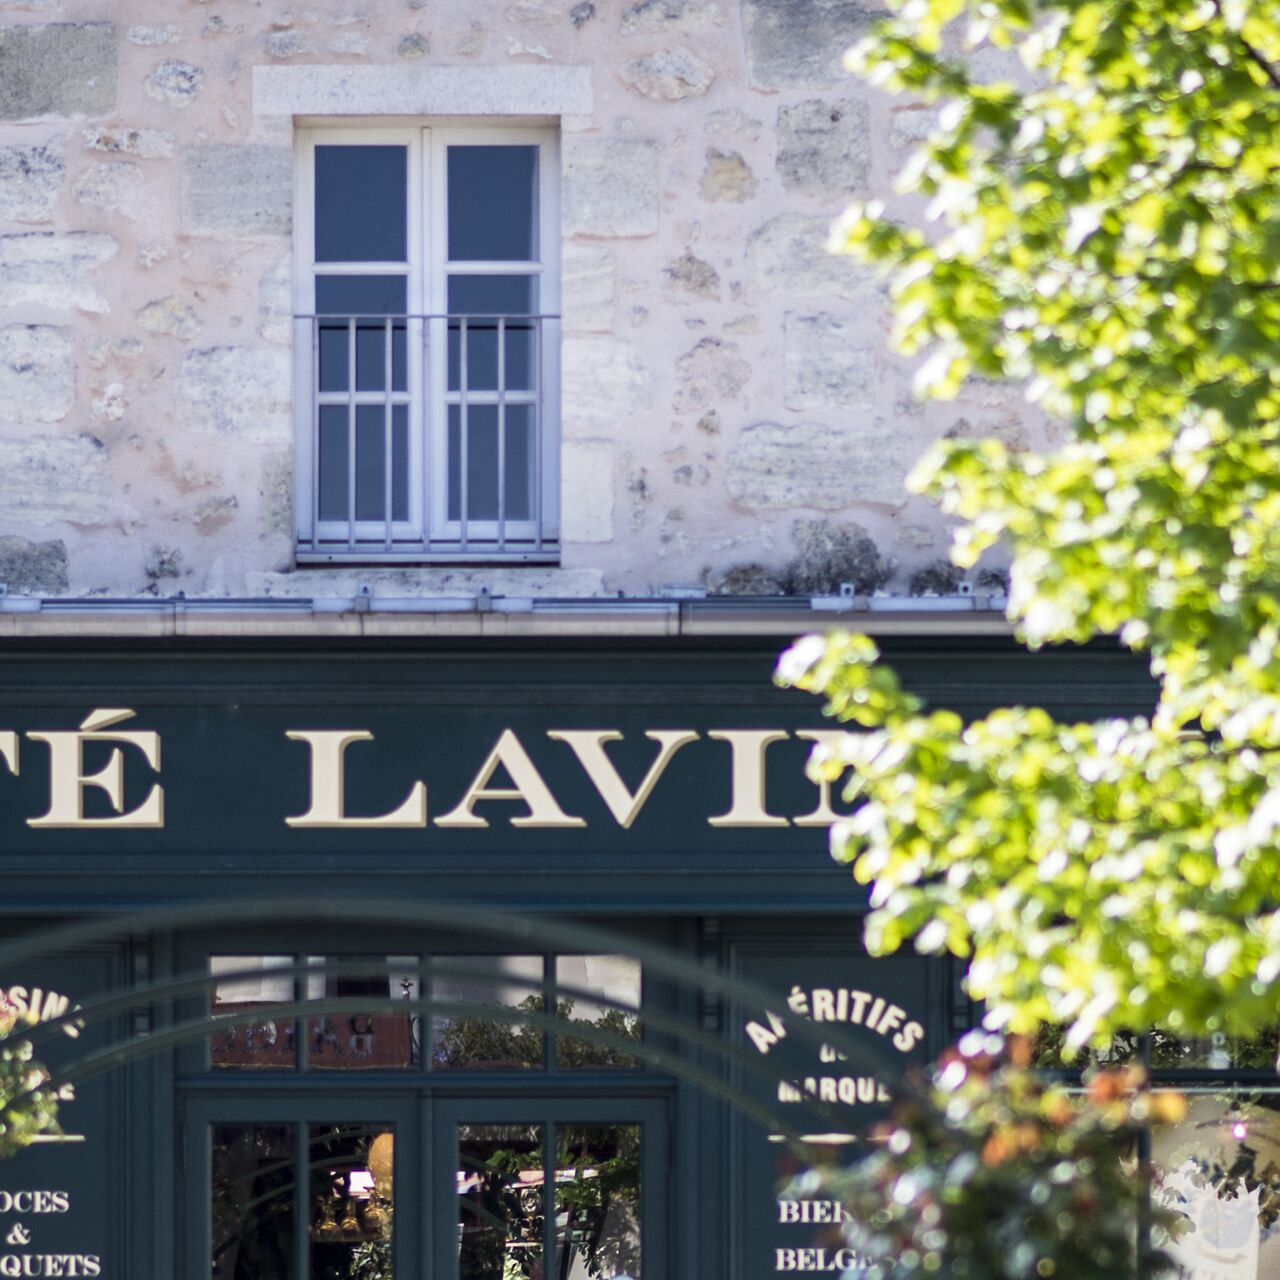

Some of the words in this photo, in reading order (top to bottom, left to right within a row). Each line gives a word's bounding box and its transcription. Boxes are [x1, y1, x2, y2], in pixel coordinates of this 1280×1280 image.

[285, 729, 860, 829] LAVI
[6, 1222, 32, 1245] &
[775, 1248, 878, 1272] BELG
